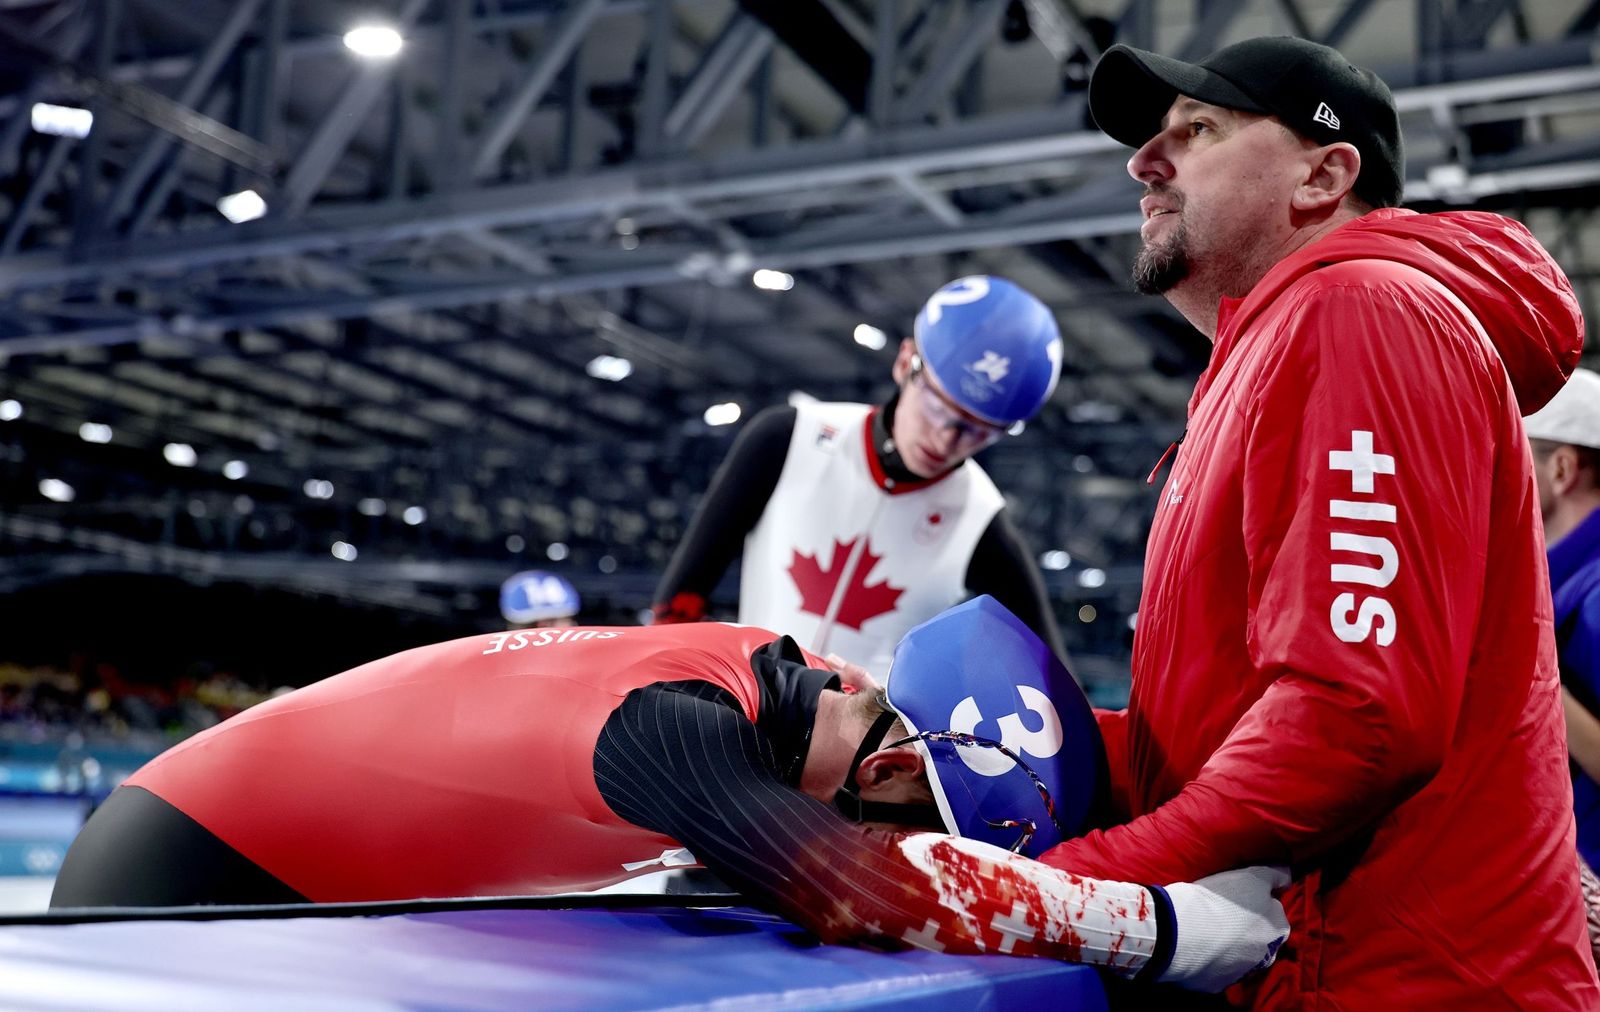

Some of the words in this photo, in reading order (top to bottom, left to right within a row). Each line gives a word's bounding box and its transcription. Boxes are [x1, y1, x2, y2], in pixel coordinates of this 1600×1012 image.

[926, 274, 991, 326] 2
[482, 629, 625, 655] SUISSE
[949, 684, 1064, 777] 3
